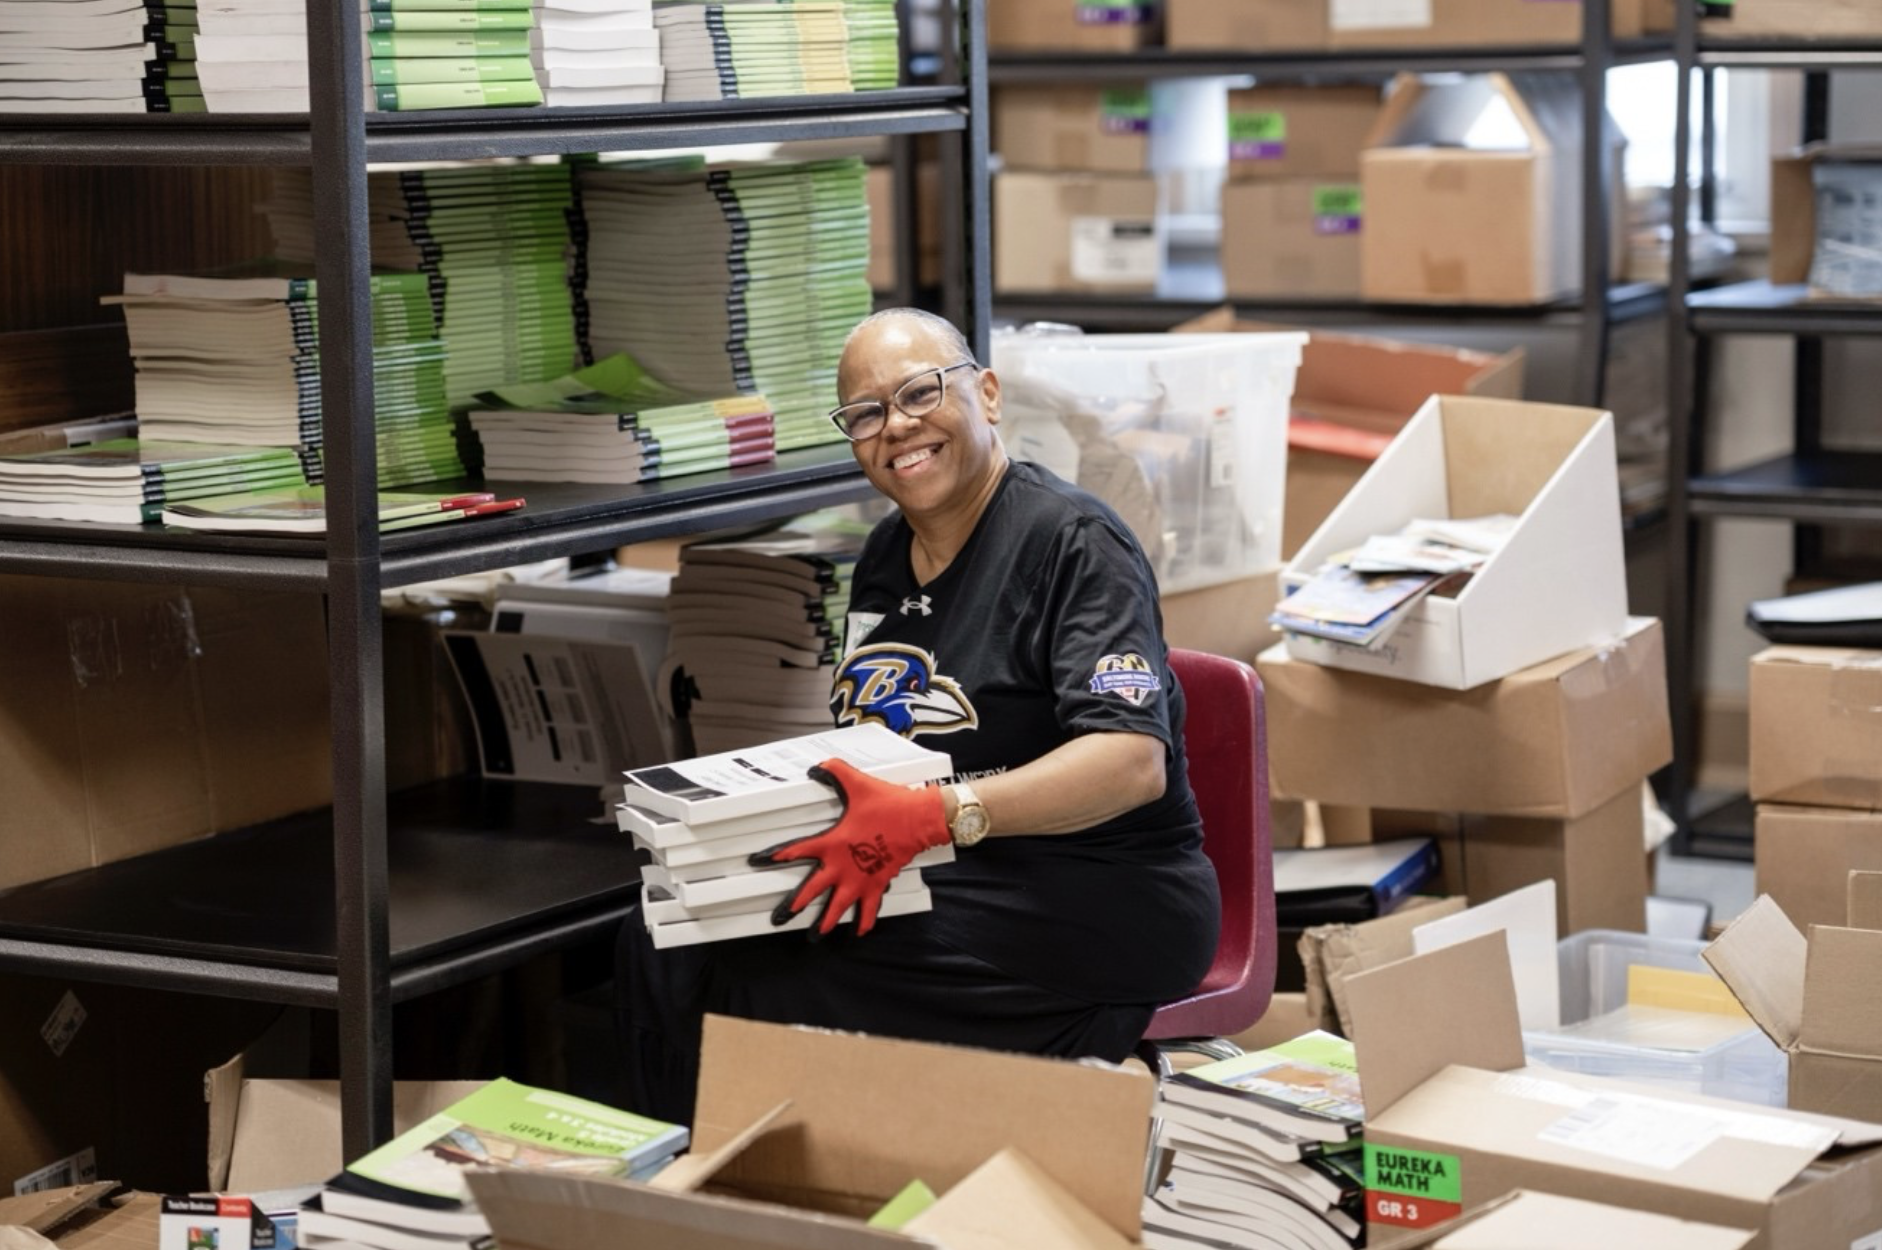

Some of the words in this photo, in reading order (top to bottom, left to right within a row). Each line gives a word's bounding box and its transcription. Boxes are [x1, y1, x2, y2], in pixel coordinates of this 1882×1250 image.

[852, 658, 909, 706] B
[509, 1122, 558, 1141] Math
[1375, 1151, 1446, 1177] EUREKA
[1377, 1169, 1429, 1192] MATH
[1376, 1199, 1402, 1218] GR
[1406, 1204, 1418, 1220] 3
